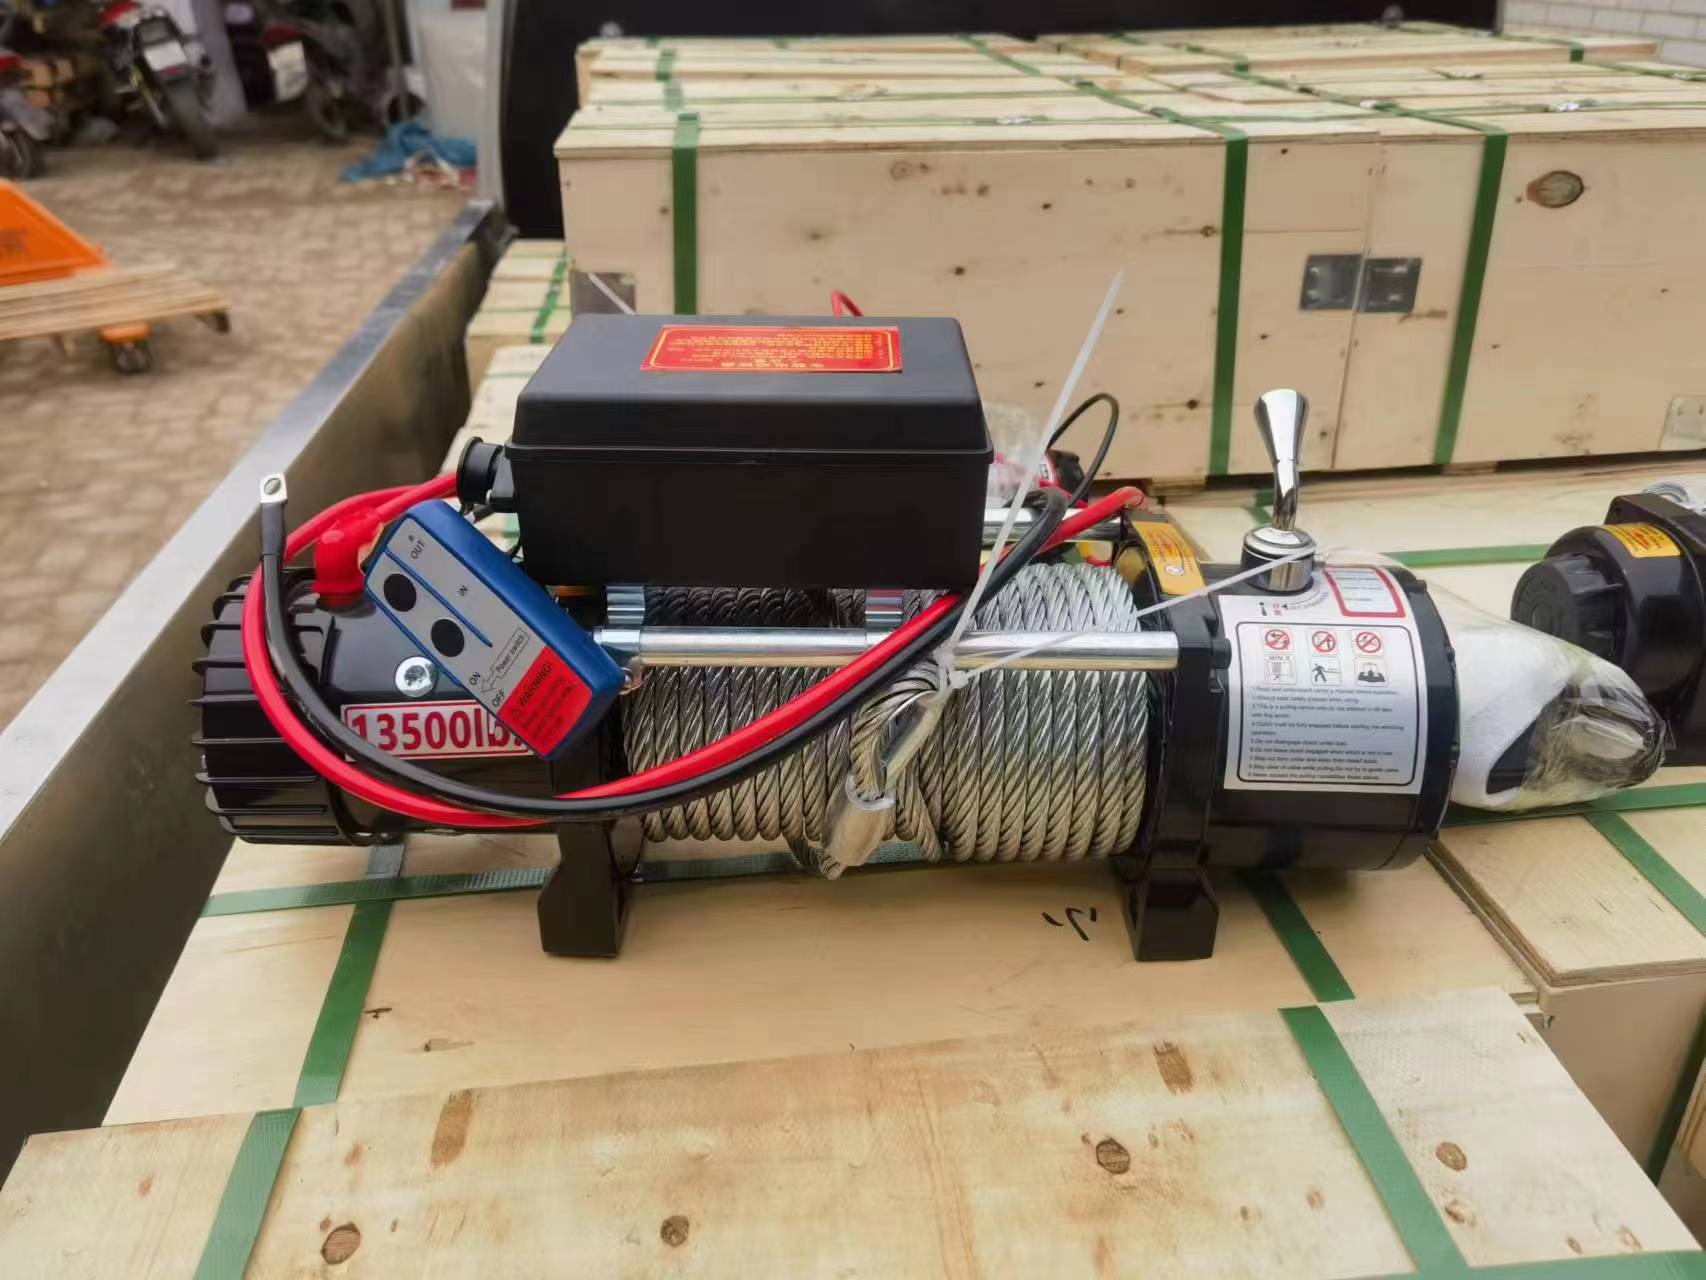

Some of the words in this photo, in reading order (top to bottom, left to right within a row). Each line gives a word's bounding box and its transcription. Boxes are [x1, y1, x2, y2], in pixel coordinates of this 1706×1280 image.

[410, 540, 425, 559] OUT
[458, 585, 468, 597] IN
[468, 671, 481, 686] ON
[491, 688, 505, 708] OFF
